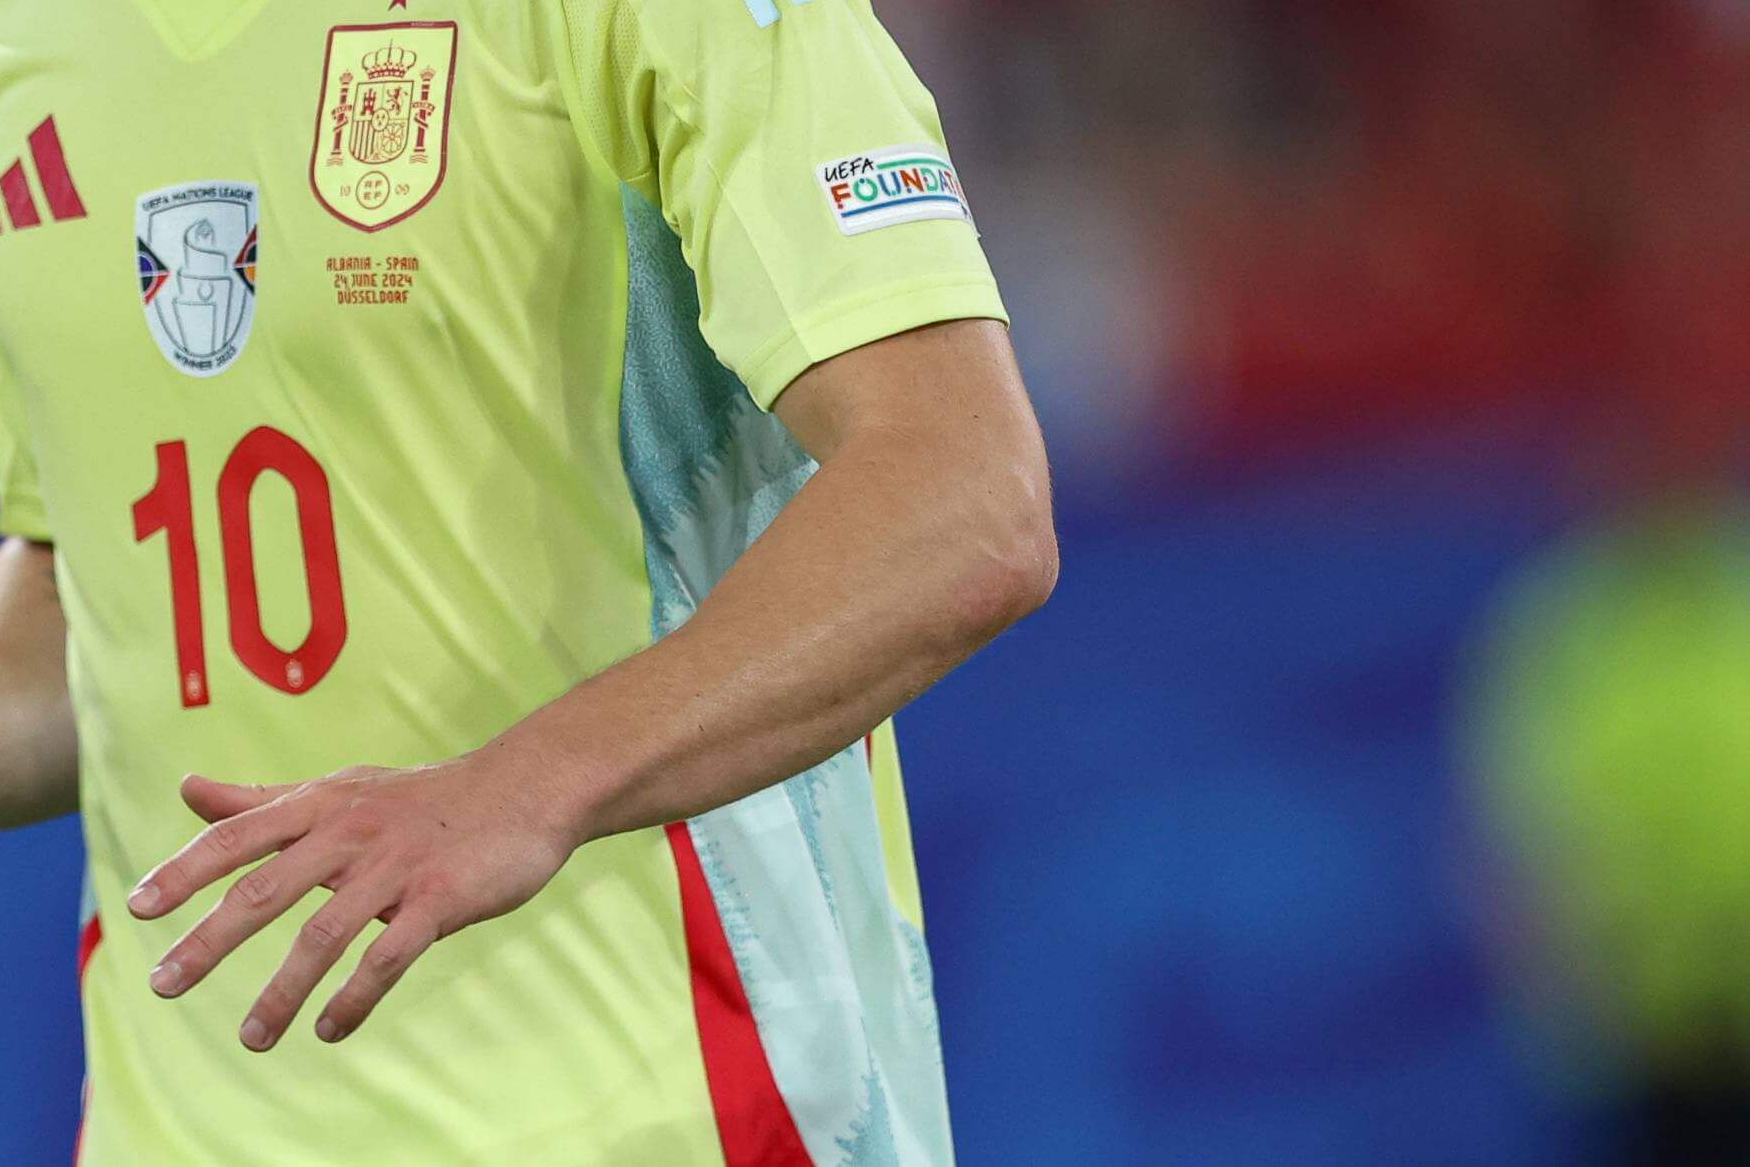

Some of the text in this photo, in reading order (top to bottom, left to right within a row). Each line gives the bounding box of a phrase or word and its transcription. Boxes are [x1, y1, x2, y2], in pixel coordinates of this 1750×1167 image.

[824, 157, 875, 182] UEFA
[142, 187, 254, 211] UEFA NATIONS LEAGUE
[326, 257, 371, 271] ALBANIA
[386, 257, 419, 271] SPAIN
[334, 273, 413, 288] 24 JUNE 2024
[174, 351, 212, 370] WINNER
[131, 425, 348, 710] 10
